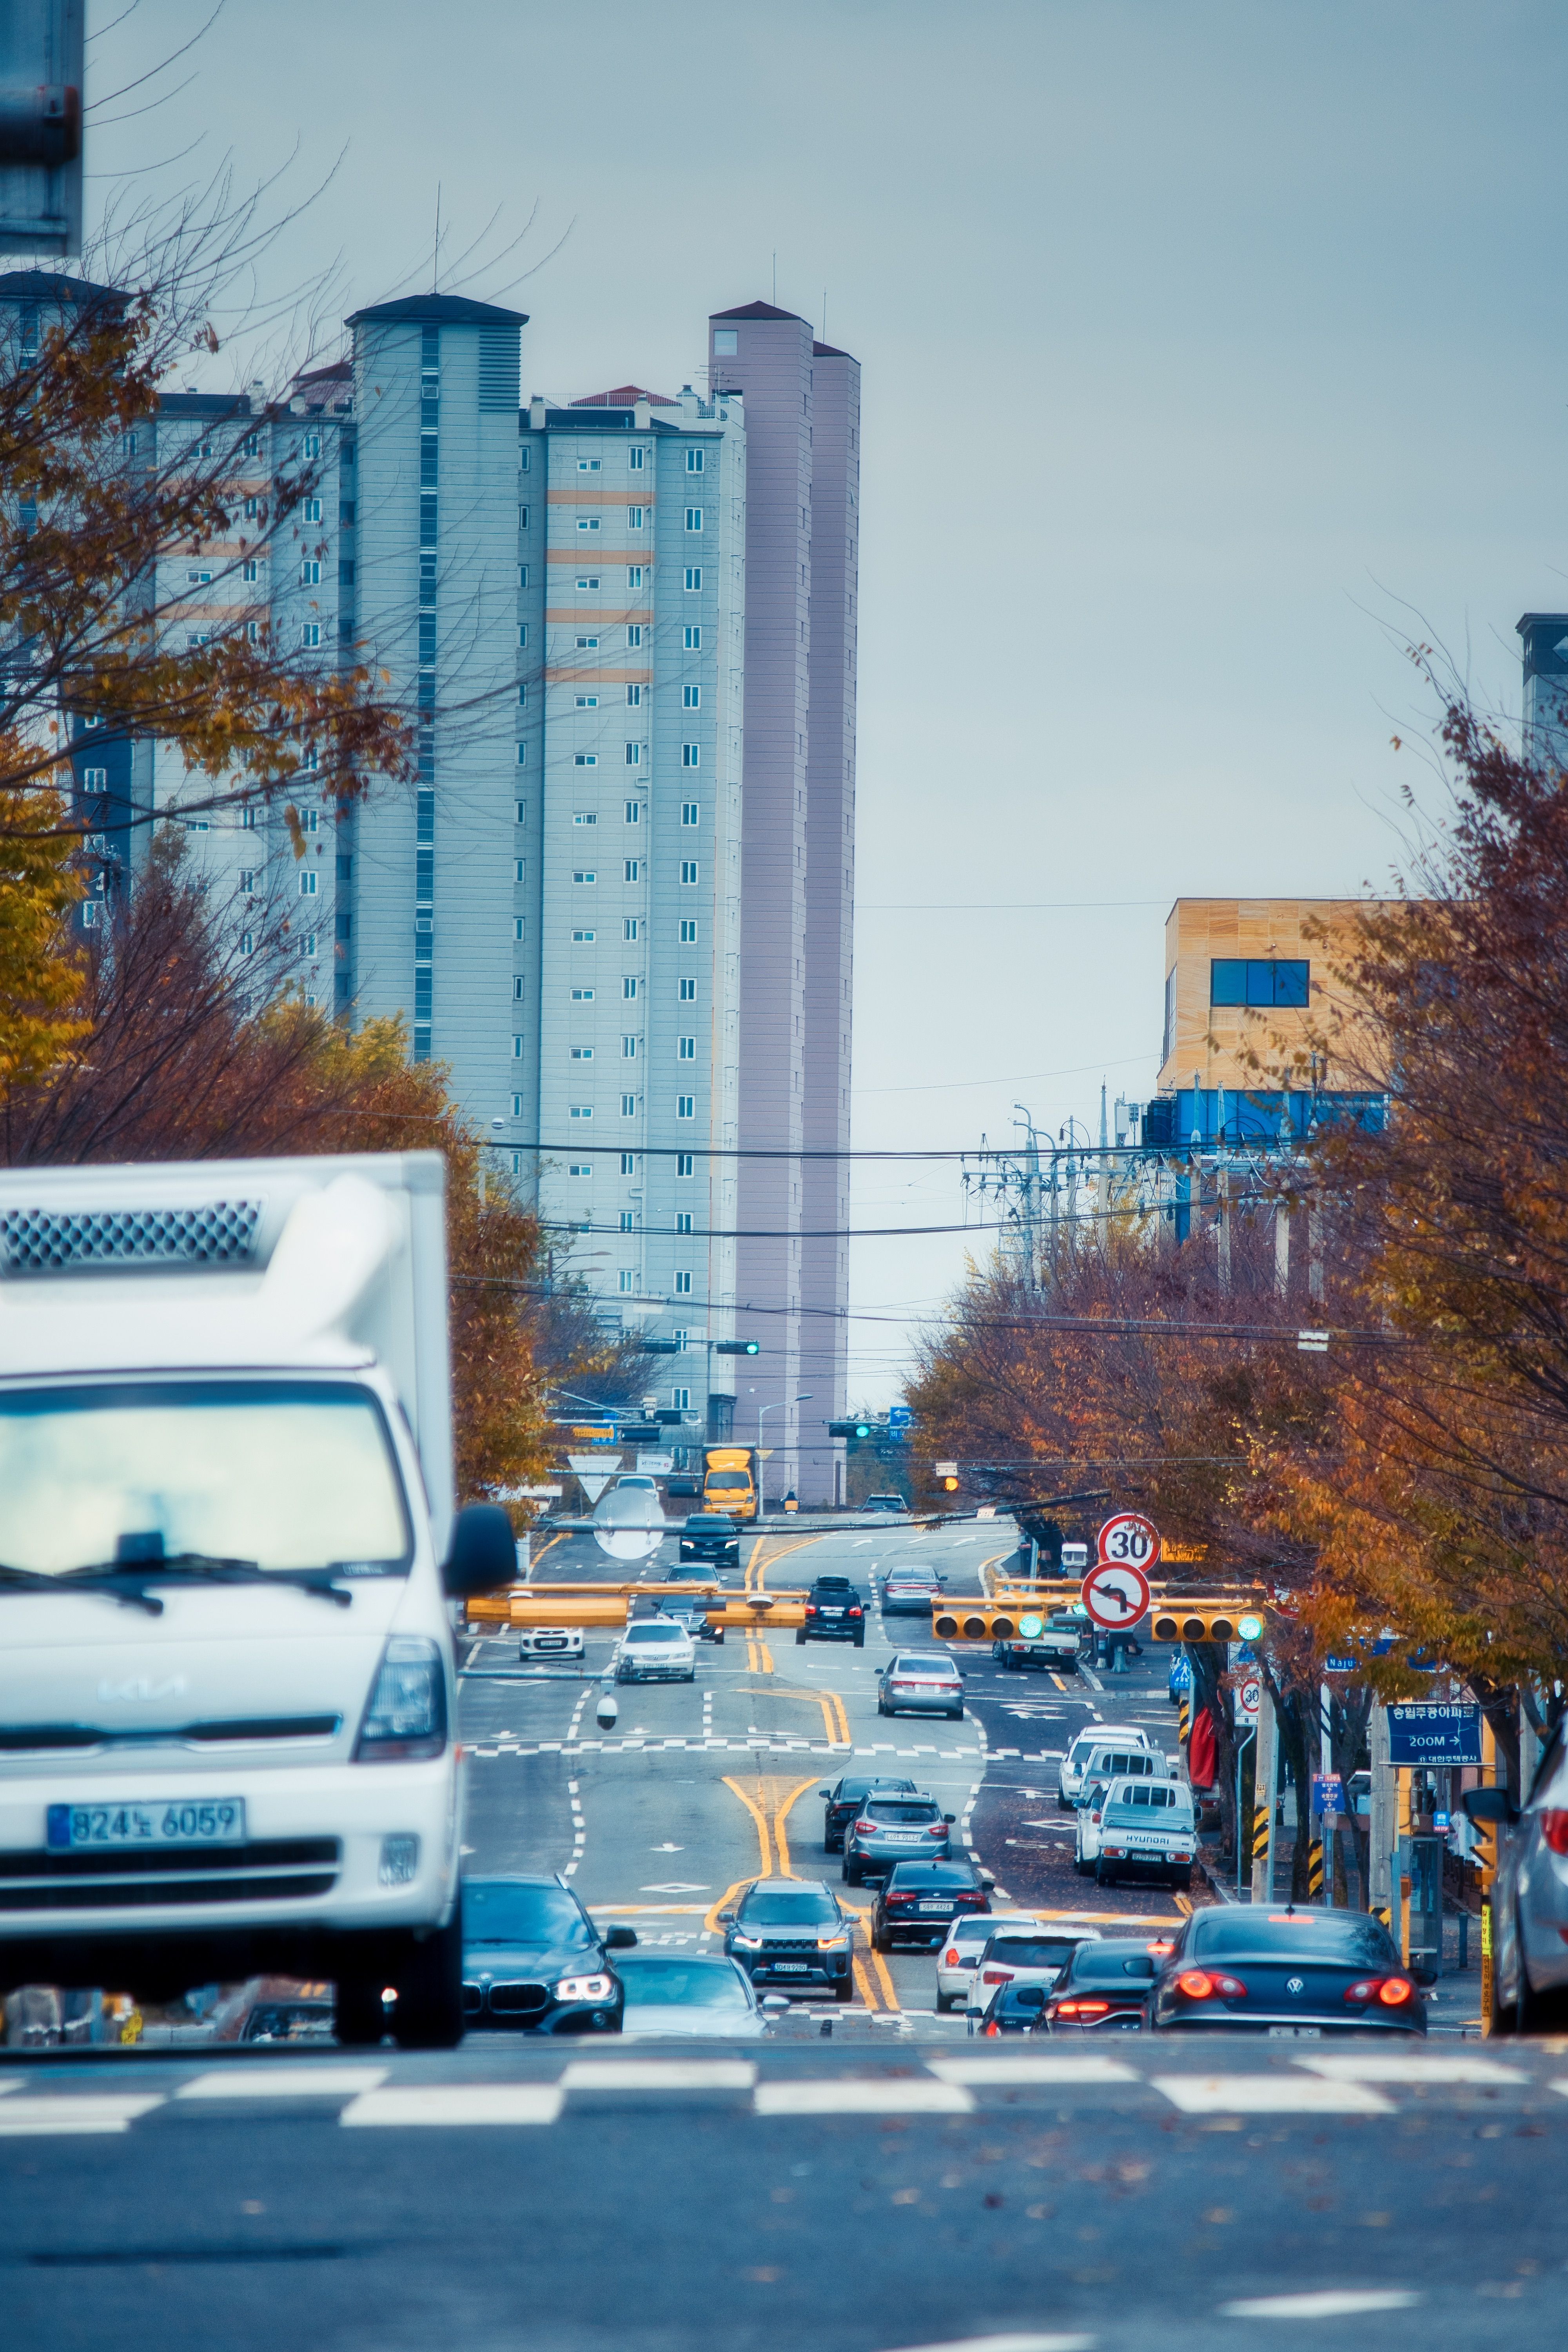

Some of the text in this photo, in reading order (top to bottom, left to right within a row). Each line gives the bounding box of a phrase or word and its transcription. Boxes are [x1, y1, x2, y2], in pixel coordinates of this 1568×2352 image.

[1111, 1532, 1147, 1559] 30
[1245, 1690, 1259, 1702] 30
[1394, 1706, 1474, 1720] 송월주공아파트
[1410, 1736, 1445, 1747] 200M
[161, 1805, 235, 1837] 6059
[1126, 1835, 1169, 1845] HYUNDAI
